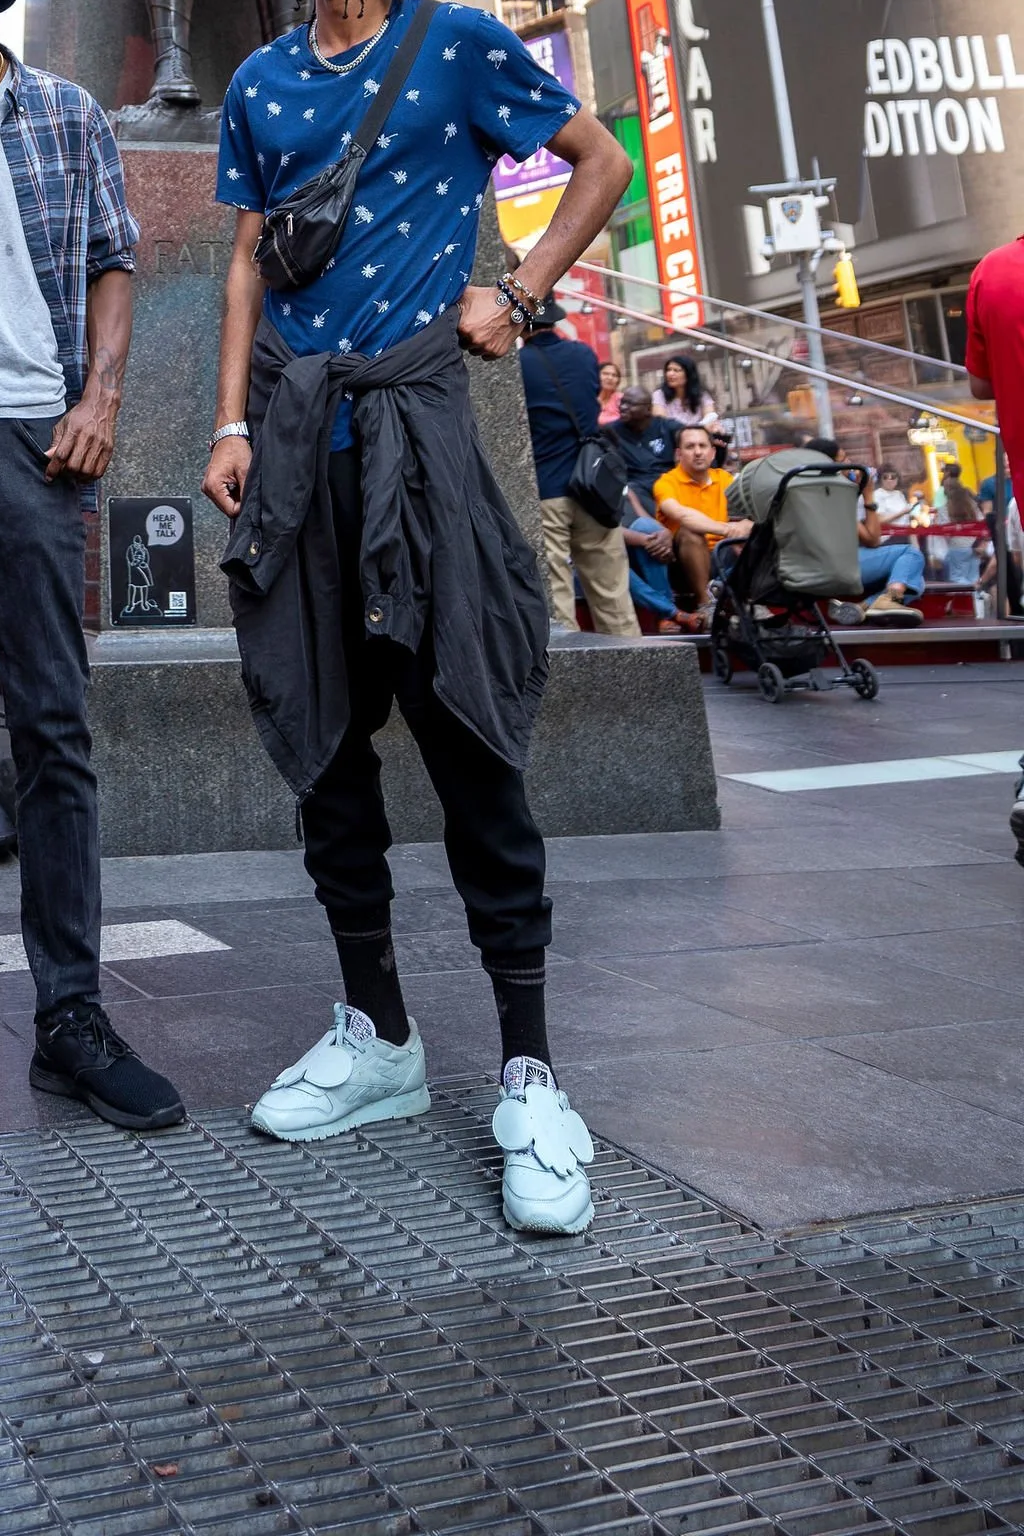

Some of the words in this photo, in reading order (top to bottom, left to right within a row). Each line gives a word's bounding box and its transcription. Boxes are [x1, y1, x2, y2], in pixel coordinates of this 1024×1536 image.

[866, 34, 1024, 94] EDBULL
[864, 96, 1006, 157] DITION
[655, 153, 690, 244] FREE
[153, 240, 234, 276] FAT
[152, 514, 177, 522] HEAR
[155, 529, 177, 538] TALK
[159, 522, 173, 530] ME
